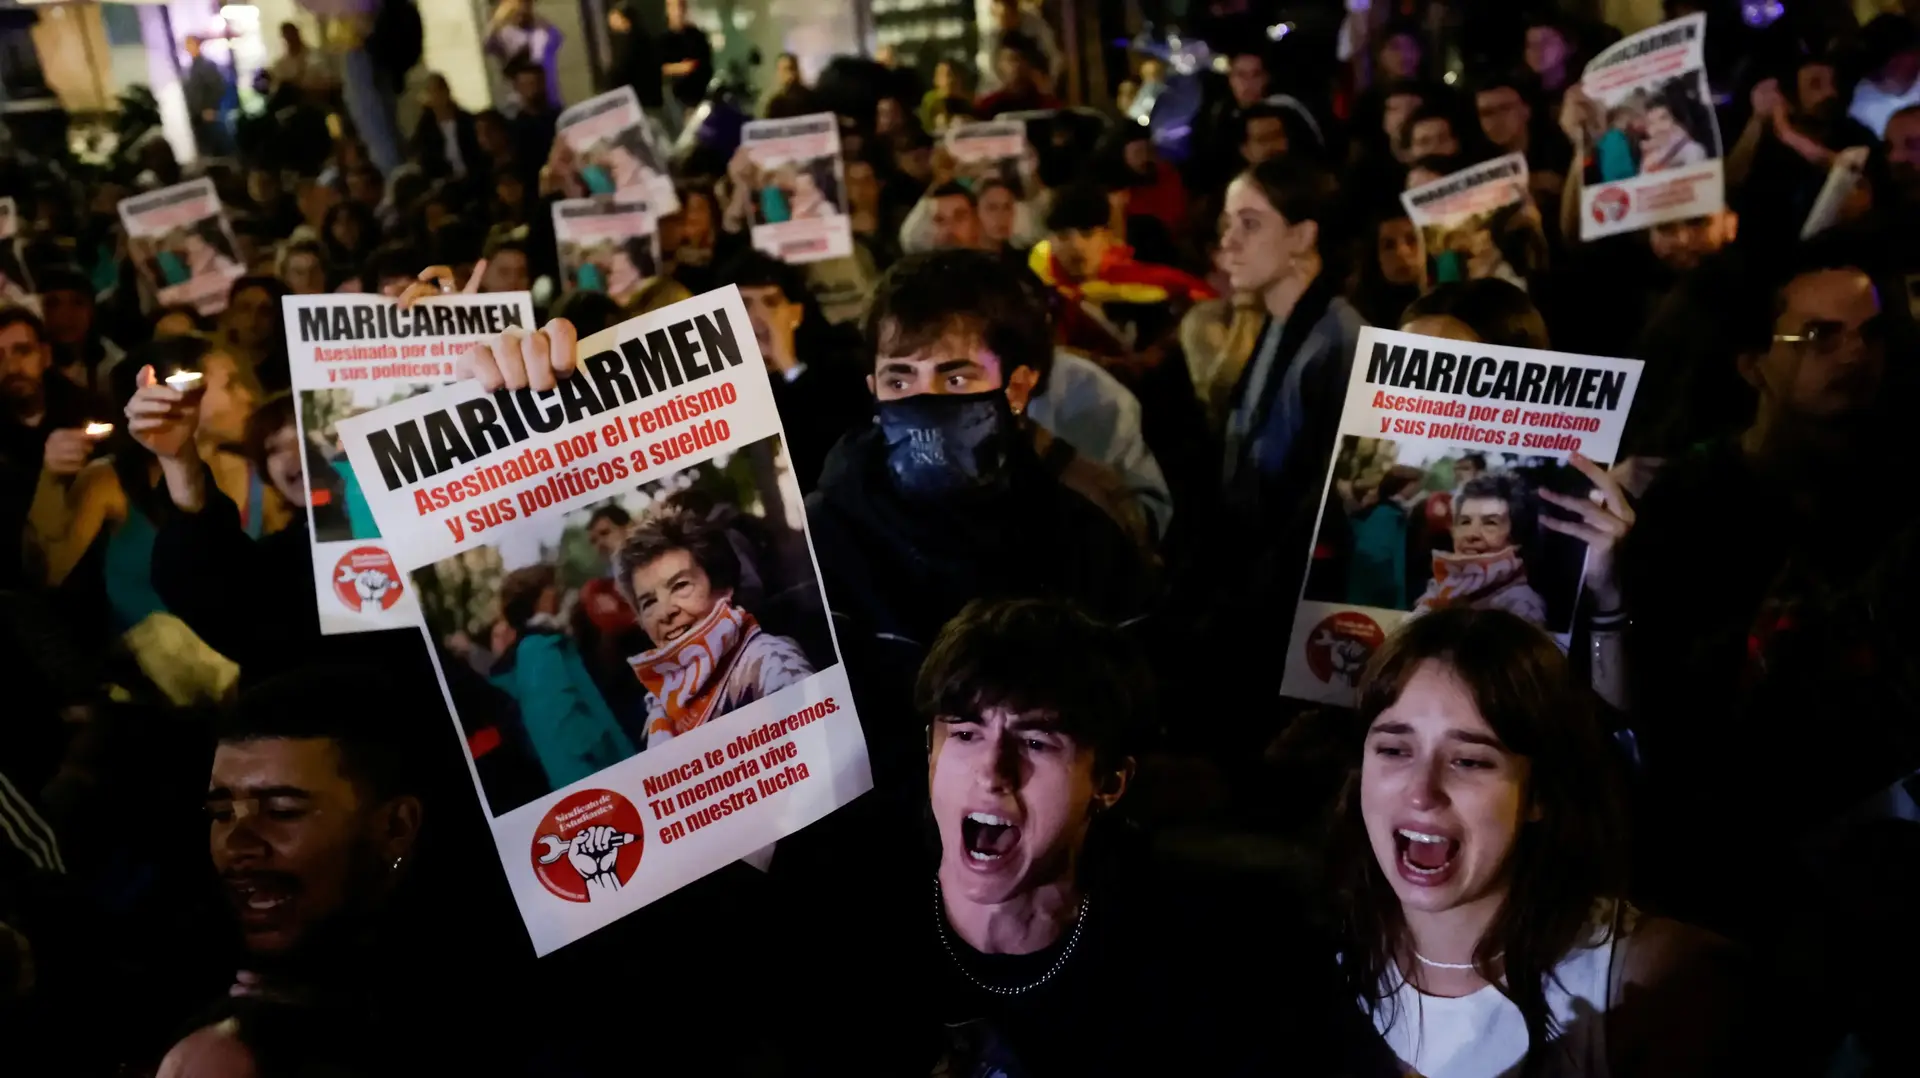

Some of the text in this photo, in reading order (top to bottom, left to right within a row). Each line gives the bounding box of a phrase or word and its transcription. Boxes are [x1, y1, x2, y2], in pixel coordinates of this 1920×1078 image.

[298, 303, 523, 342] MARICARMEN
[314, 344, 398, 362] Asesinada
[401, 345, 426, 363] por
[430, 341, 445, 357] el
[339, 366, 368, 380] sus
[443, 363, 453, 376] a
[1366, 342, 1627, 411] MARICARMEN
[366, 308, 743, 491] MARICARMEN
[1372, 390, 1601, 432] Asesinada por el rentismo
[413, 382, 737, 516] Asesinada por el rentismo
[1380, 416, 1581, 451] y sus políticos a sueldo
[444, 418, 731, 543] y sus políticos a sueldo
[642, 697, 841, 798] Nunca te olvidaremos.
[648, 740, 798, 821] Tu memoria vive
[659, 762, 810, 845] en nuestra lucha
[555, 795, 612, 822] Sindicato de
[559, 804, 614, 832] Estudiantes
